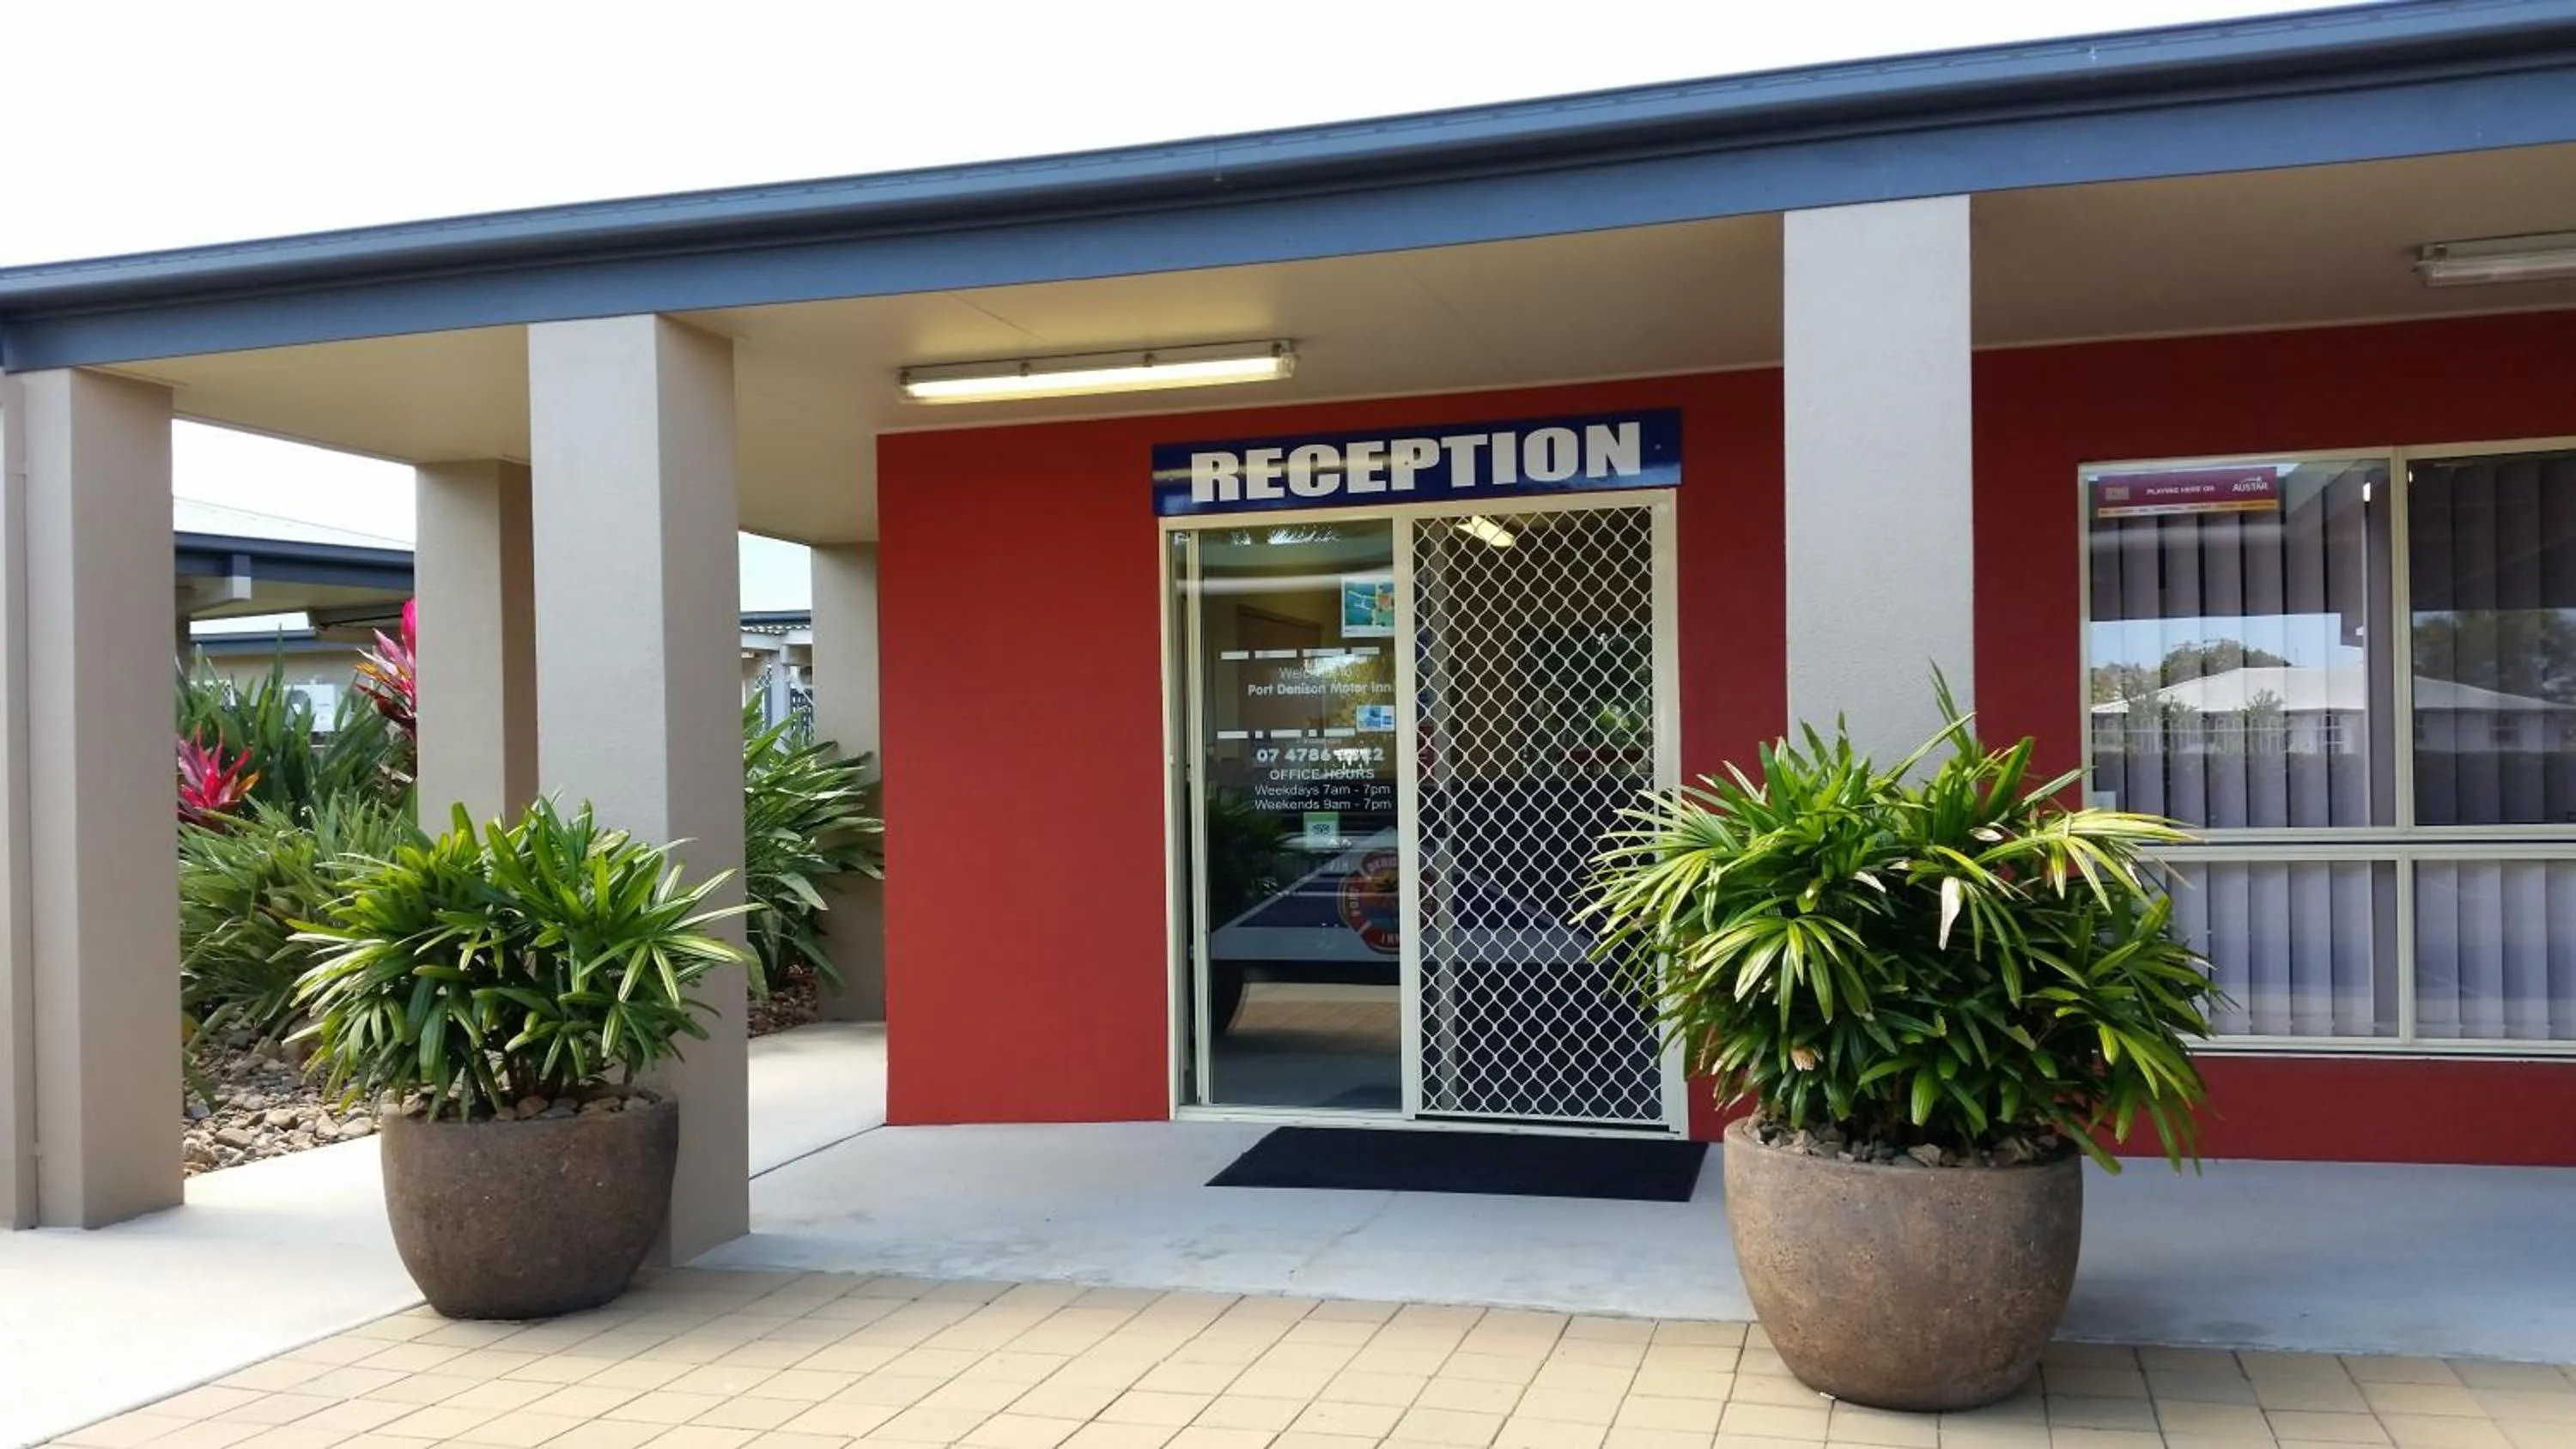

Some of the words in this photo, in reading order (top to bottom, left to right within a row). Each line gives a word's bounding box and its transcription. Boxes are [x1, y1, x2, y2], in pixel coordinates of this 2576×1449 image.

[1191, 421, 1642, 503] RECEPTION
[2232, 481, 2269, 493] AUSTAR
[1279, 665, 1337, 679] Welc
[1248, 683, 1273, 696] Port
[1277, 682, 1327, 695] Denison
[1331, 682, 1368, 694] Motor
[1371, 681, 1392, 693] Inn
[1256, 748, 1279, 761] 07
[1285, 748, 1332, 761] 4786
[1269, 768, 1321, 781] OFFICE
[1325, 767, 1375, 780] HOURS
[1255, 784, 1320, 797] Weekdays
[1323, 784, 1351, 796] 7am
[1364, 783, 1391, 797] 7pm
[1255, 799, 1320, 811] Weekends
[1323, 798, 1351, 811] 9am
[1364, 798, 1392, 812] 7pm
